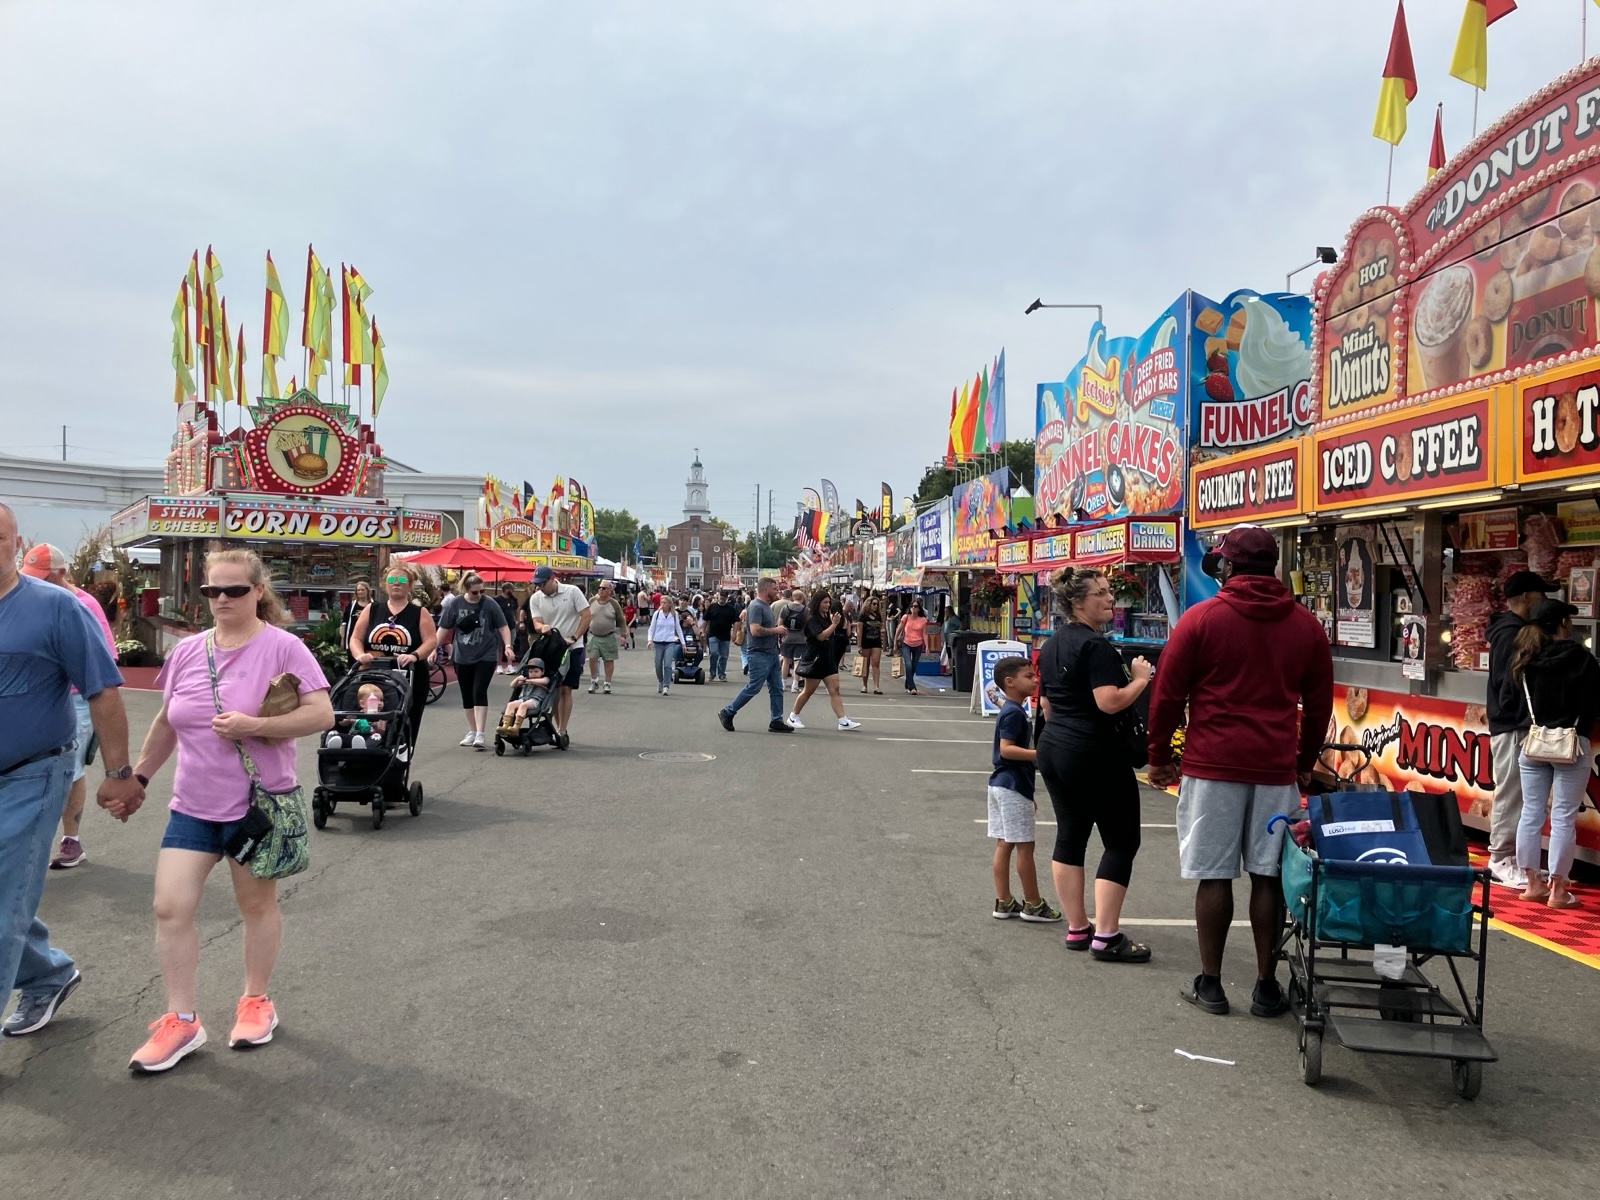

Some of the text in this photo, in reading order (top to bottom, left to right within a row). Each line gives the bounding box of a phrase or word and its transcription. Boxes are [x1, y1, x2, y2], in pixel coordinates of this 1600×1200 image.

[1443, 105, 1568, 226] DONUT
[1575, 88, 1600, 136] F
[1359, 257, 1388, 286] HOT
[1512, 295, 1588, 358] DONUT
[1342, 325, 1375, 356] Mini
[1137, 351, 1175, 385] DEEP FRIED
[1330, 341, 1390, 406] Donuts
[1133, 372, 1178, 407] CANDY BARS
[1201, 380, 1314, 446] FUNNEL C
[1039, 422, 1064, 447] SUNDAES
[1039, 420, 1176, 518] FUNNEL CAKES
[1322, 441, 1372, 490] ICED
[1086, 494, 1106, 513] OREO
[1198, 470, 1246, 511] GOURMET
[160, 507, 207, 519] STEAK
[225, 509, 395, 538] CORN DOGS
[408, 518, 435, 531] STEAK
[882, 495, 891, 530] BBQ
[150, 521, 217, 533] & CHEESE
[411, 532, 440, 544] CHEESE
[496, 523, 537, 539] LEMONADE
[1138, 525, 1166, 535] COLD
[958, 536, 974, 552] SLUSH
[1034, 537, 1069, 560] FUNNEL CAKES
[1077, 529, 1124, 554] DOUGH NUGGETS
[1133, 535, 1174, 549] DRINKS
[551, 560, 579, 568] LEMONADE
[371, 644, 410, 653] GOOD VIBES
[1362, 712, 1493, 788] Original MINI
